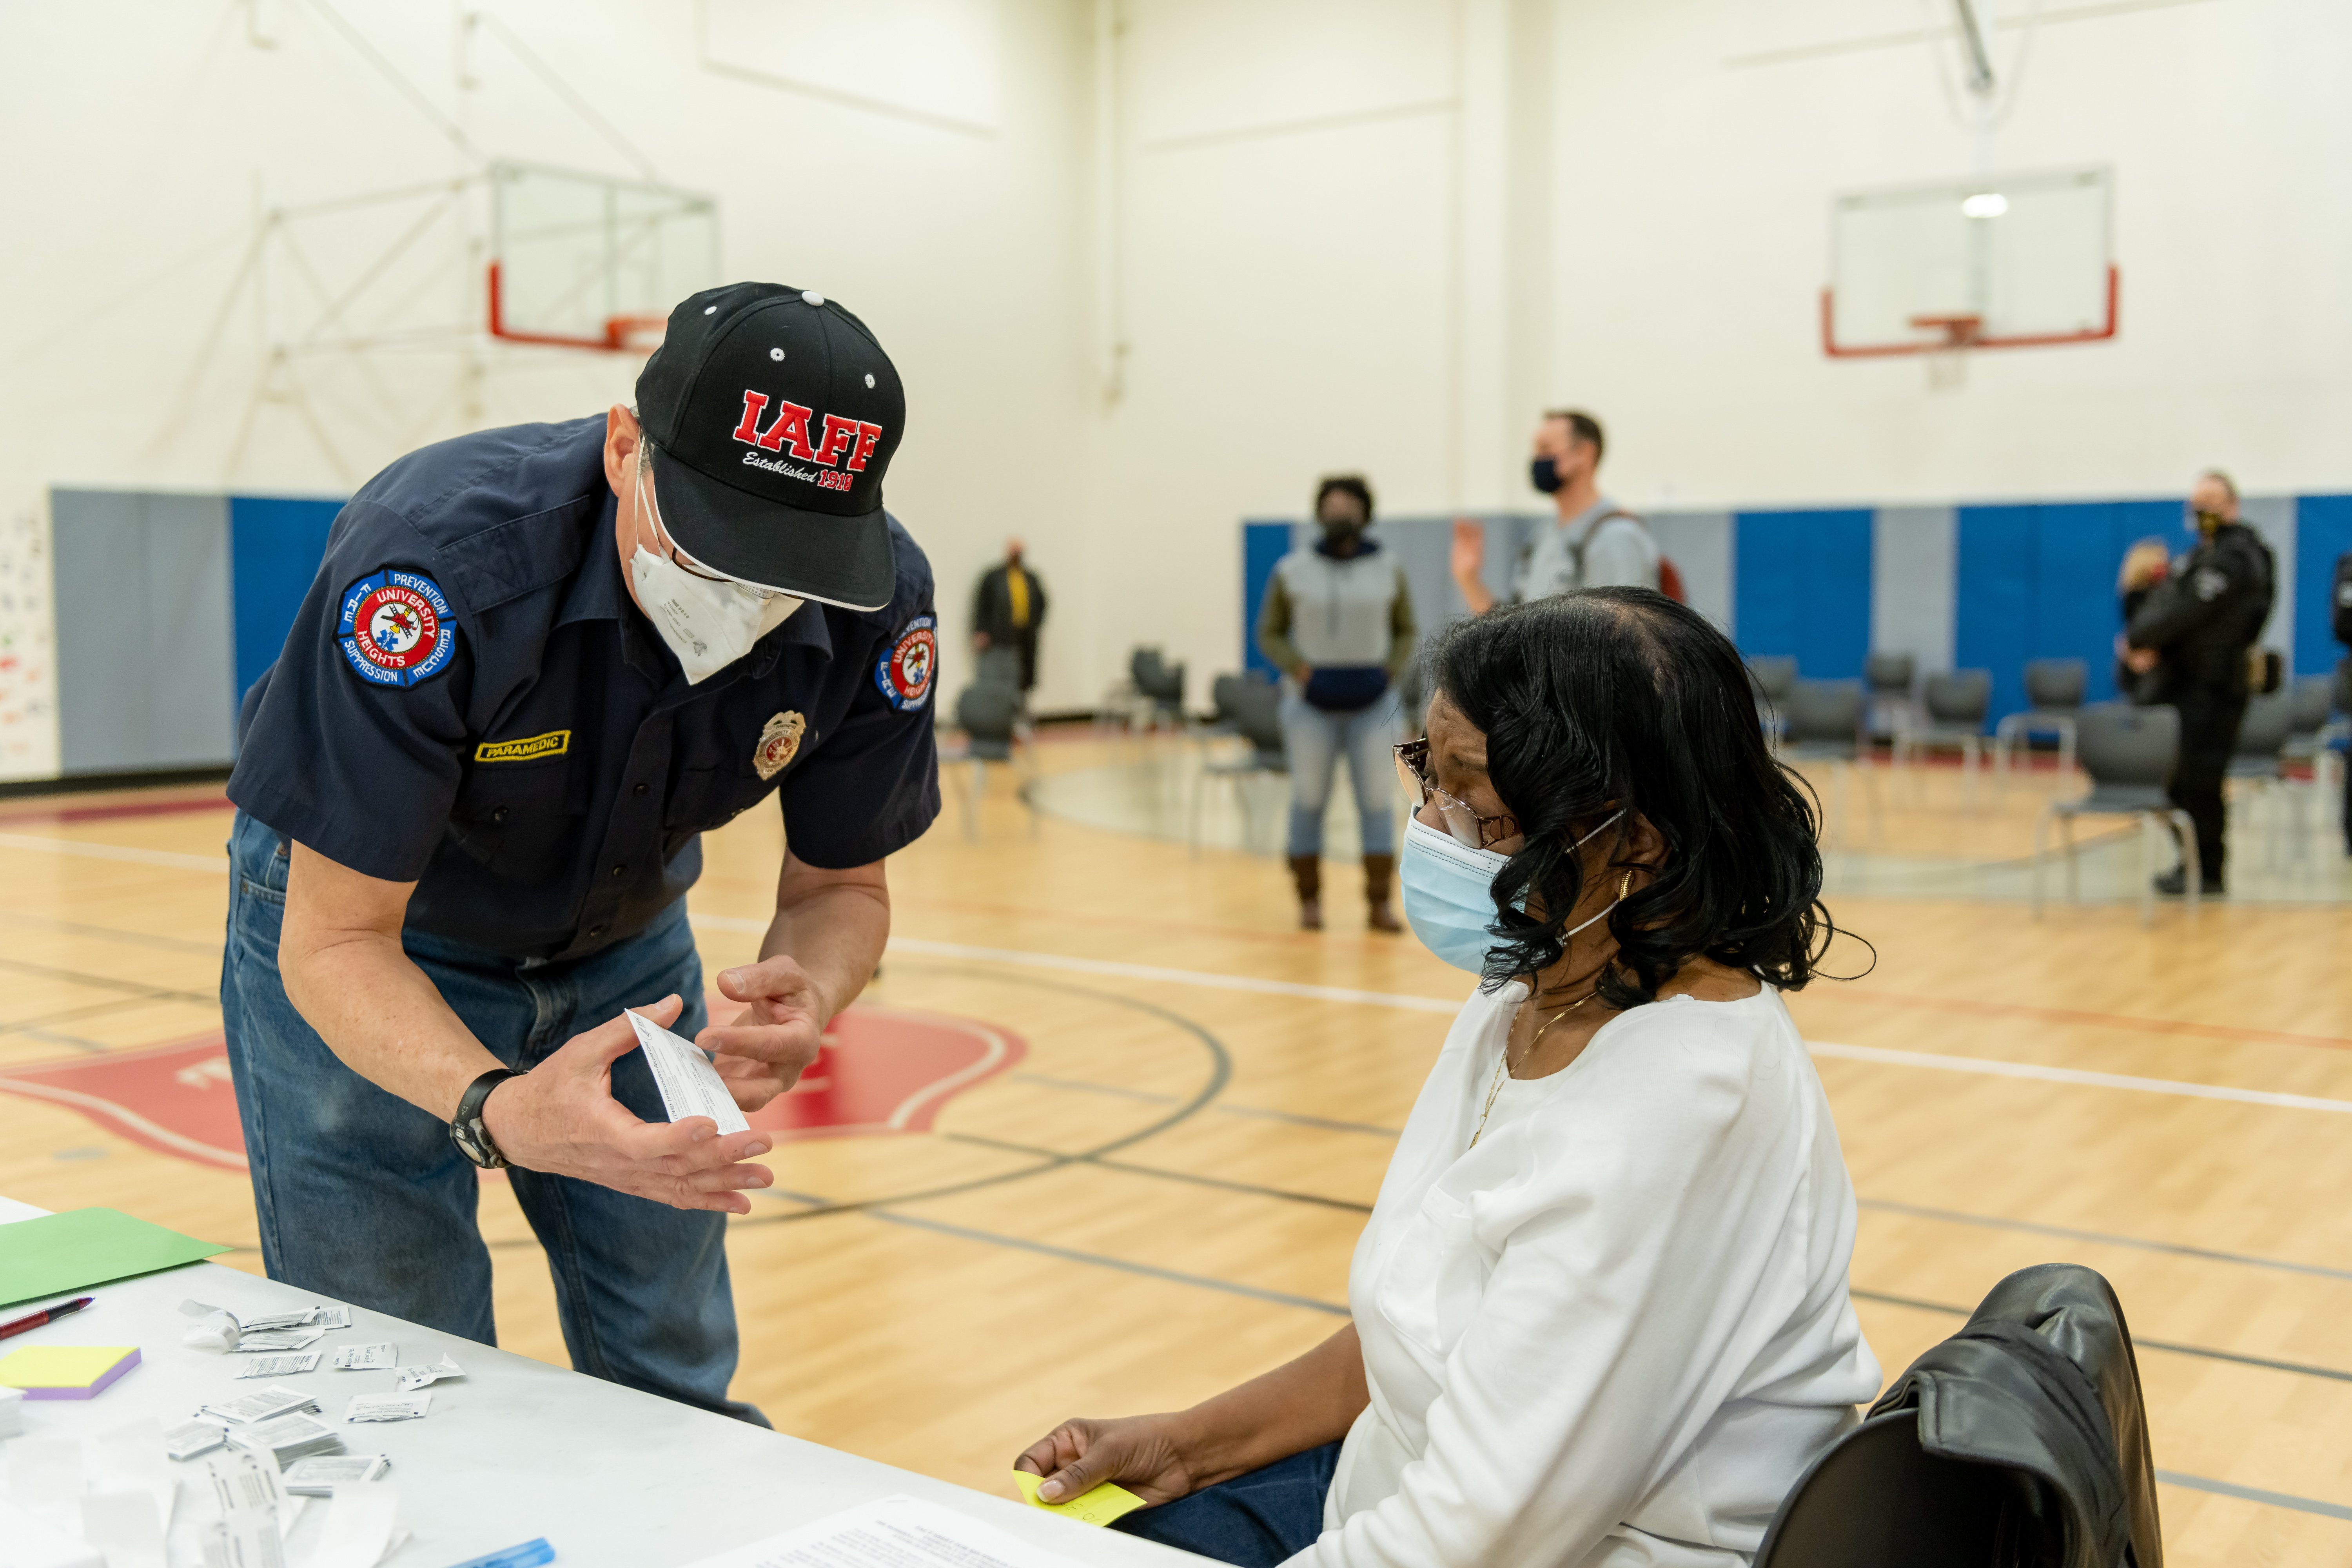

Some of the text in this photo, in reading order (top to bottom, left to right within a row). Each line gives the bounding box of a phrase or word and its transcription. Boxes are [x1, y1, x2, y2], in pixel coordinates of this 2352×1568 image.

[733, 389, 882, 472] IAFF
[743, 452, 852, 492] Established 1918
[344, 583, 372, 623] FIRE
[377, 590, 435, 638] UNIVERSITY
[394, 573, 448, 615] PREVENTION
[345, 641, 397, 682] SUPPRESSION
[358, 630, 405, 666] HEIGHTS
[413, 629, 451, 678] RESCUE
[880, 661, 896, 698] FIRE
[486, 737, 558, 757] PARAMEDIC
[648, 1052, 658, 1068] Record
[657, 1069, 670, 1095] Vaccination
